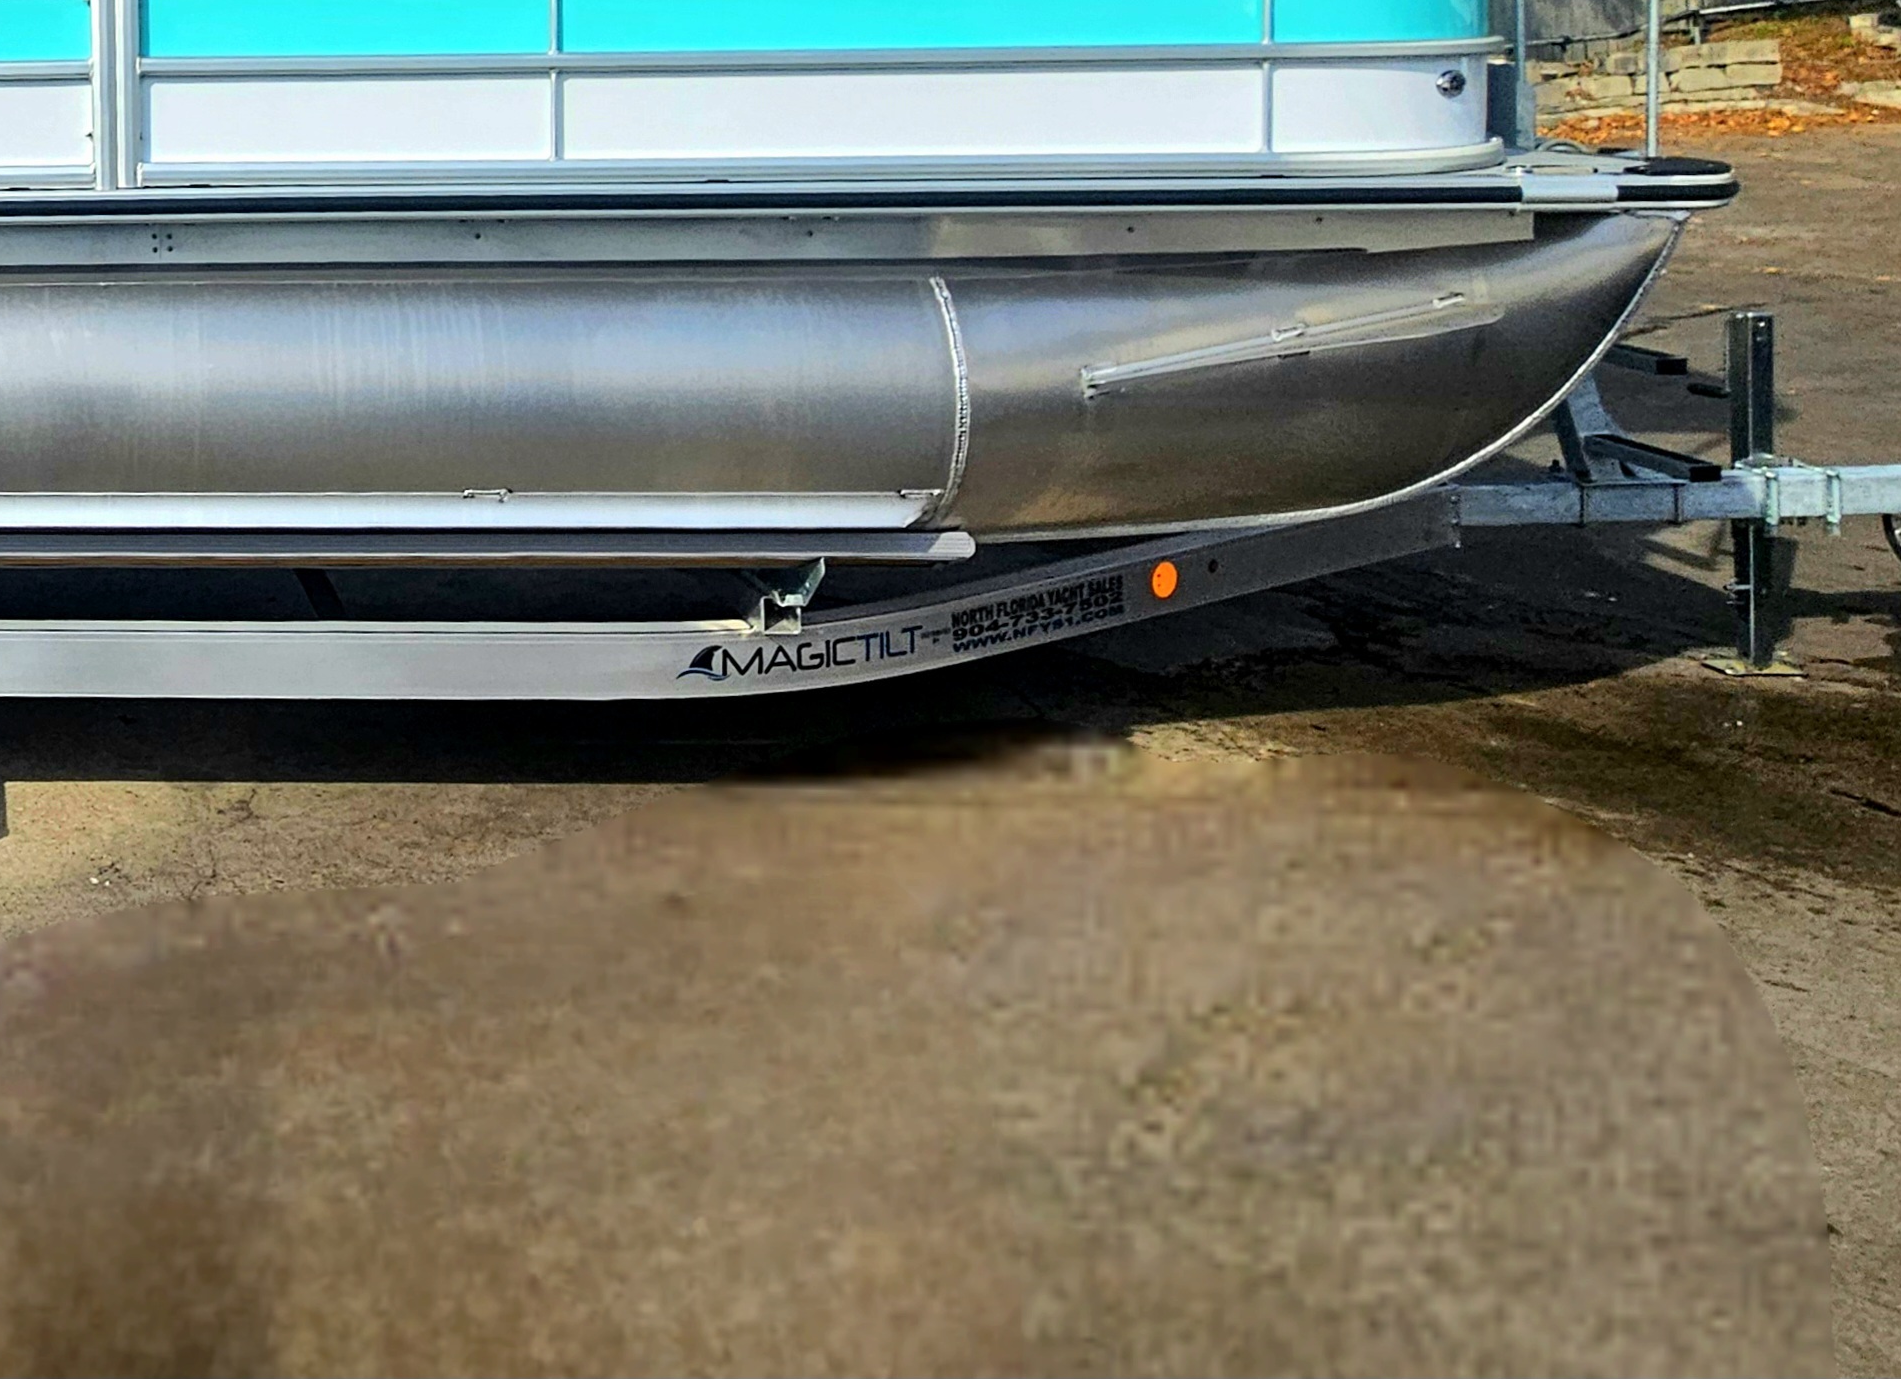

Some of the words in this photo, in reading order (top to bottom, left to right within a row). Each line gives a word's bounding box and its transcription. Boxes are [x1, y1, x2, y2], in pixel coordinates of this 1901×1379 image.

[951, 605, 994, 628] NORTH
[997, 593, 1045, 619] FLORIDA
[1047, 583, 1086, 607] YACHT
[1088, 575, 1124, 597] SALES
[952, 591, 1124, 642] 904-733-7502
[721, 625, 923, 678] MAGICTILT
